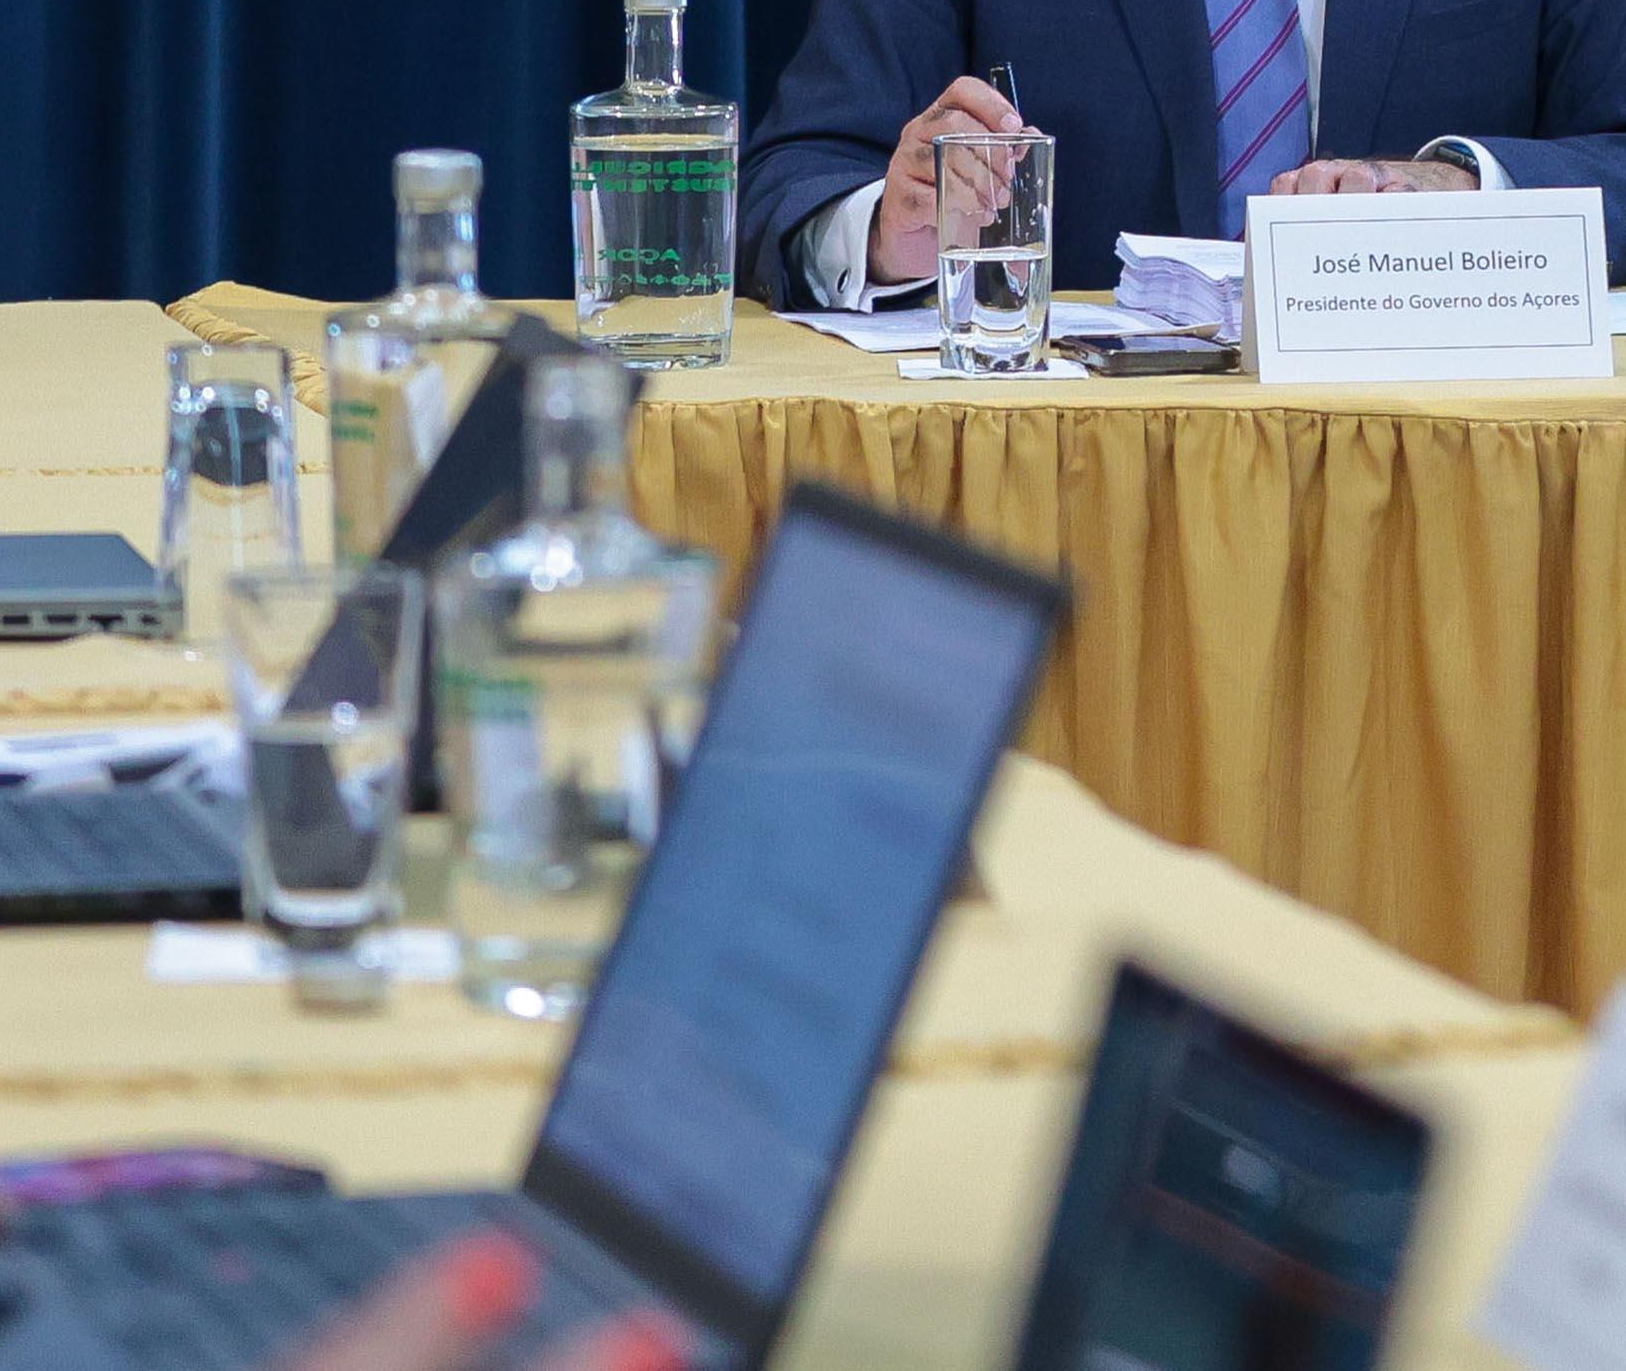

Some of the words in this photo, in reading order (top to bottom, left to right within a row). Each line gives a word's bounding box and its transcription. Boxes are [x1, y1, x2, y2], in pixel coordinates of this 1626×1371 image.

[1312, 252, 1361, 275] José
[1368, 251, 1454, 273] Manuel
[1462, 249, 1548, 270] Bolieiro
[1286, 296, 1377, 313] Presidente
[1382, 294, 1404, 310] do
[1408, 293, 1483, 310] Governo
[1487, 292, 1519, 309] dos
[1522, 291, 1580, 311] Açores
